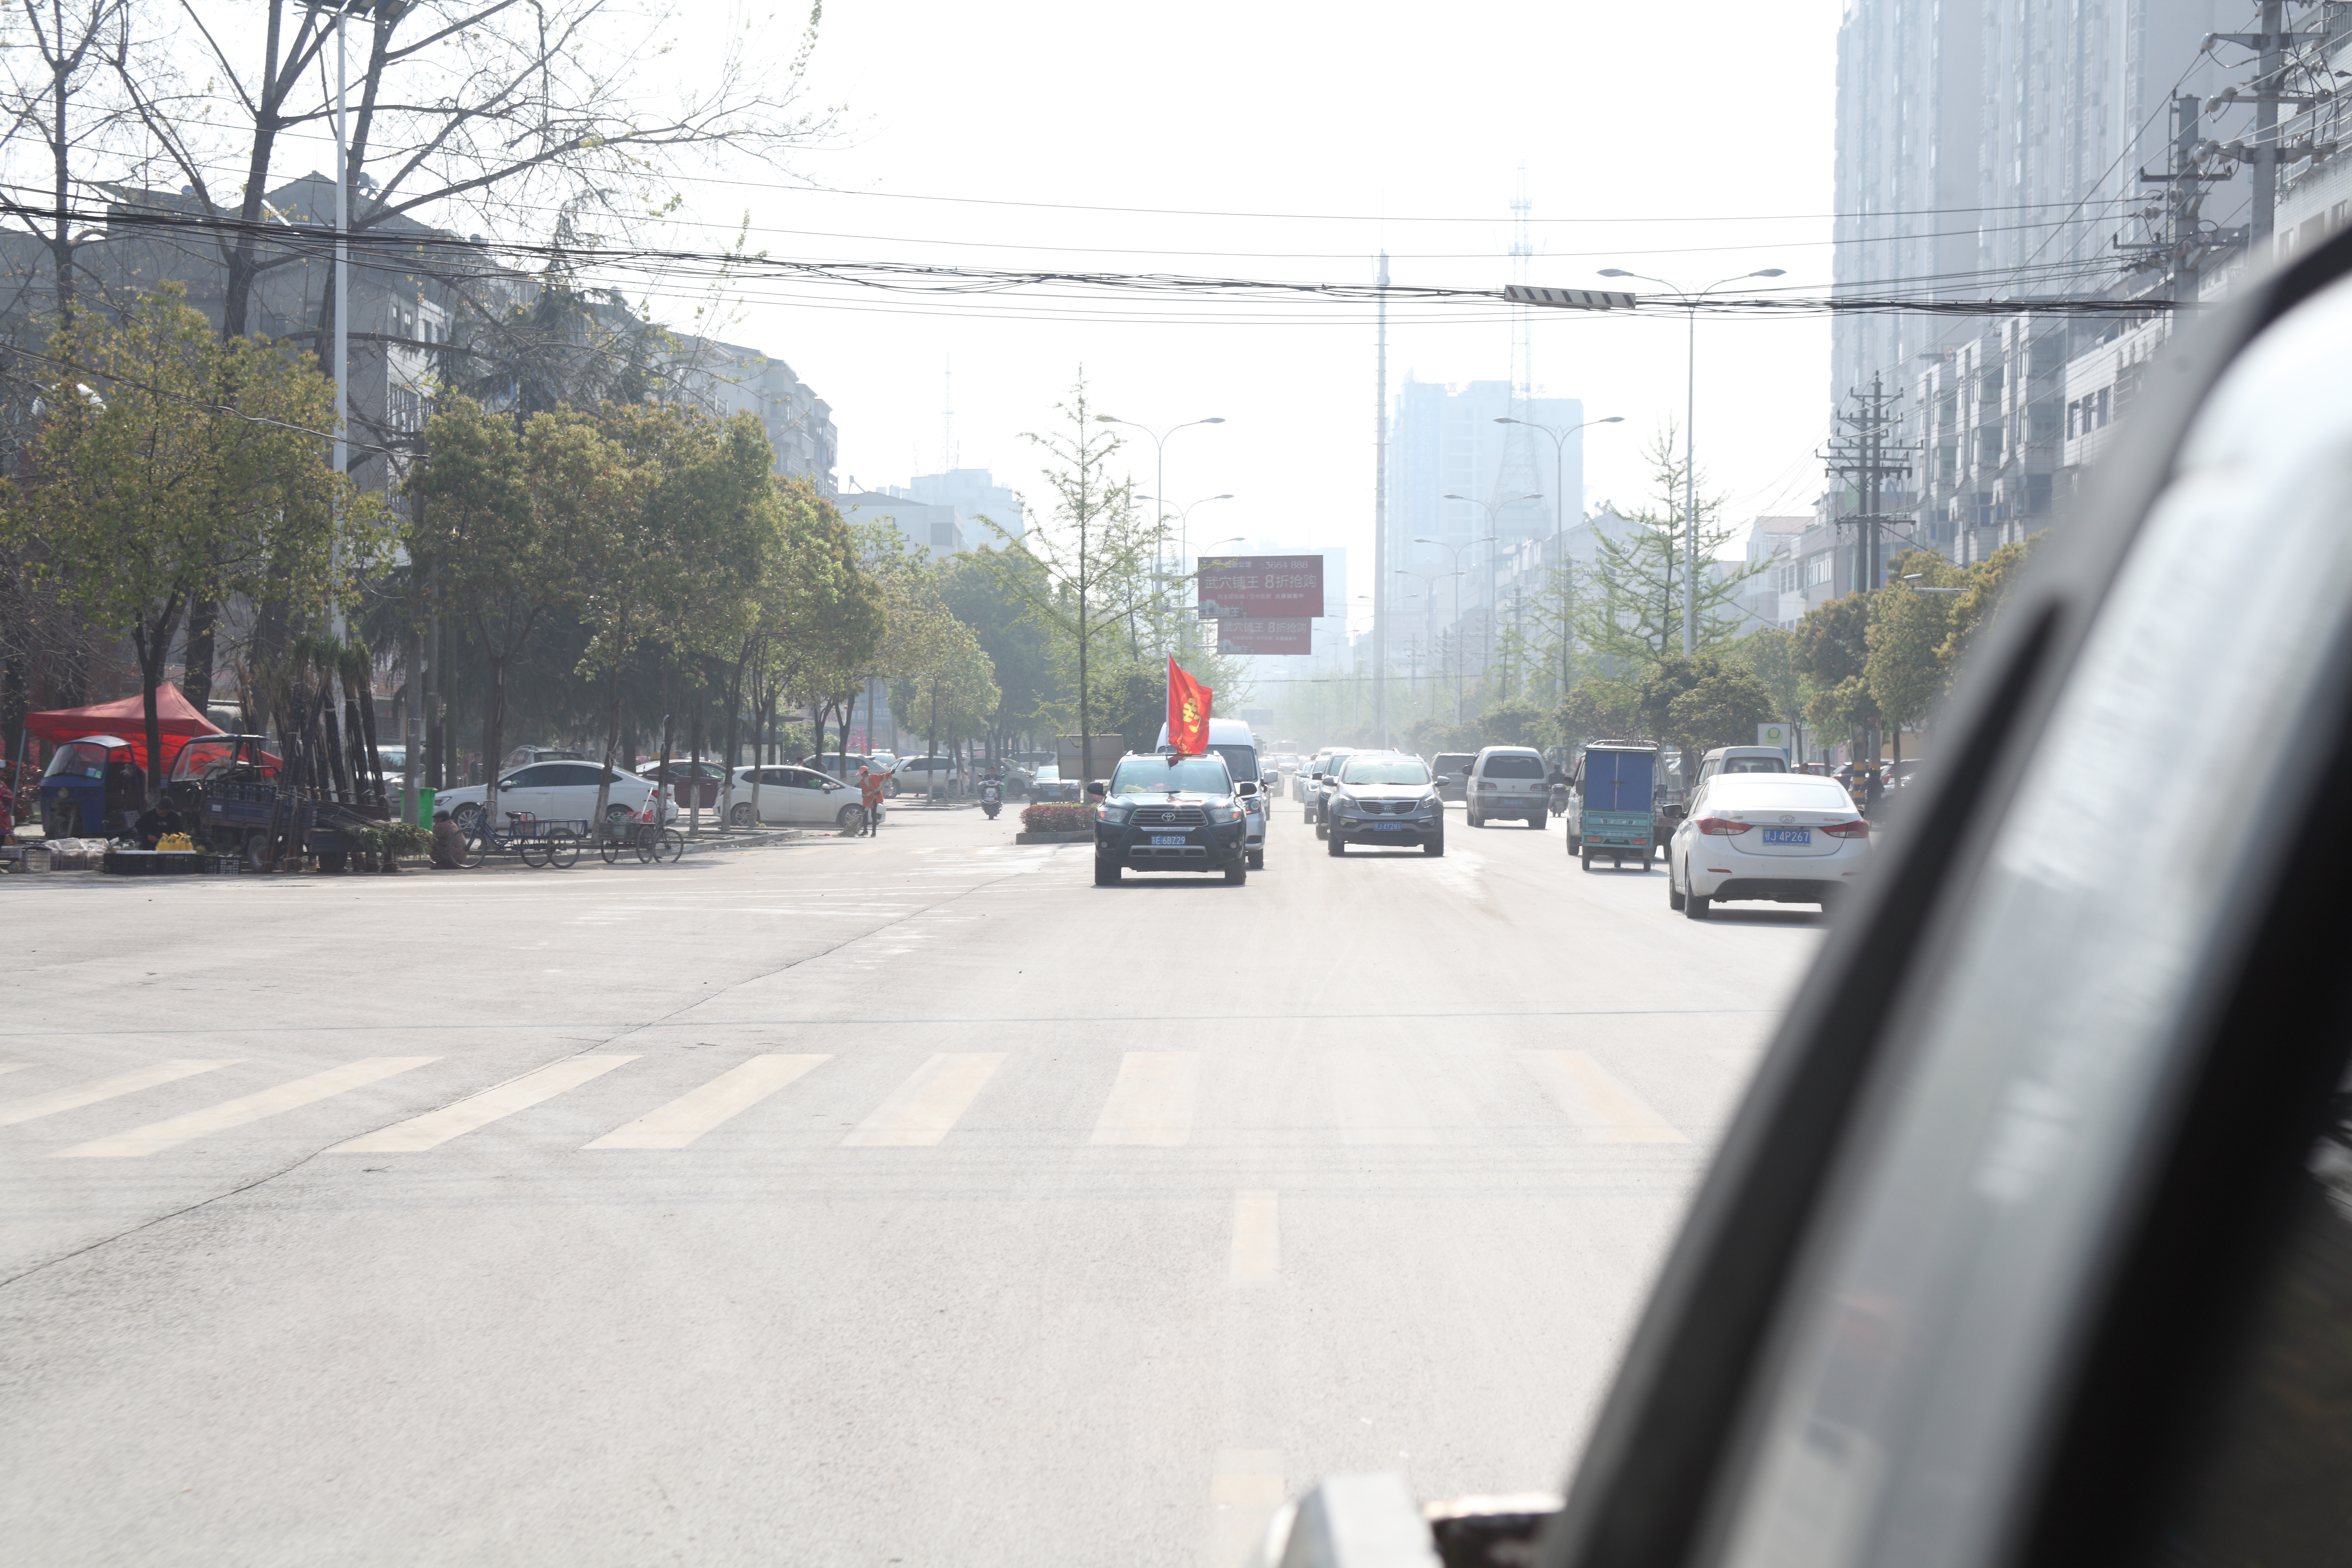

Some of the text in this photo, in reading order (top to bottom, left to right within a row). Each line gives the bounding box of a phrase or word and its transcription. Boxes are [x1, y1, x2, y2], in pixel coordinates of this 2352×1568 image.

[1264, 561, 1288, 570] 3664
[1291, 560, 1308, 569] 888
[1204, 574, 1316, 590] 武穴铺王 8折抢购
[1222, 622, 1307, 633] 武穴铺王 8折抢购
